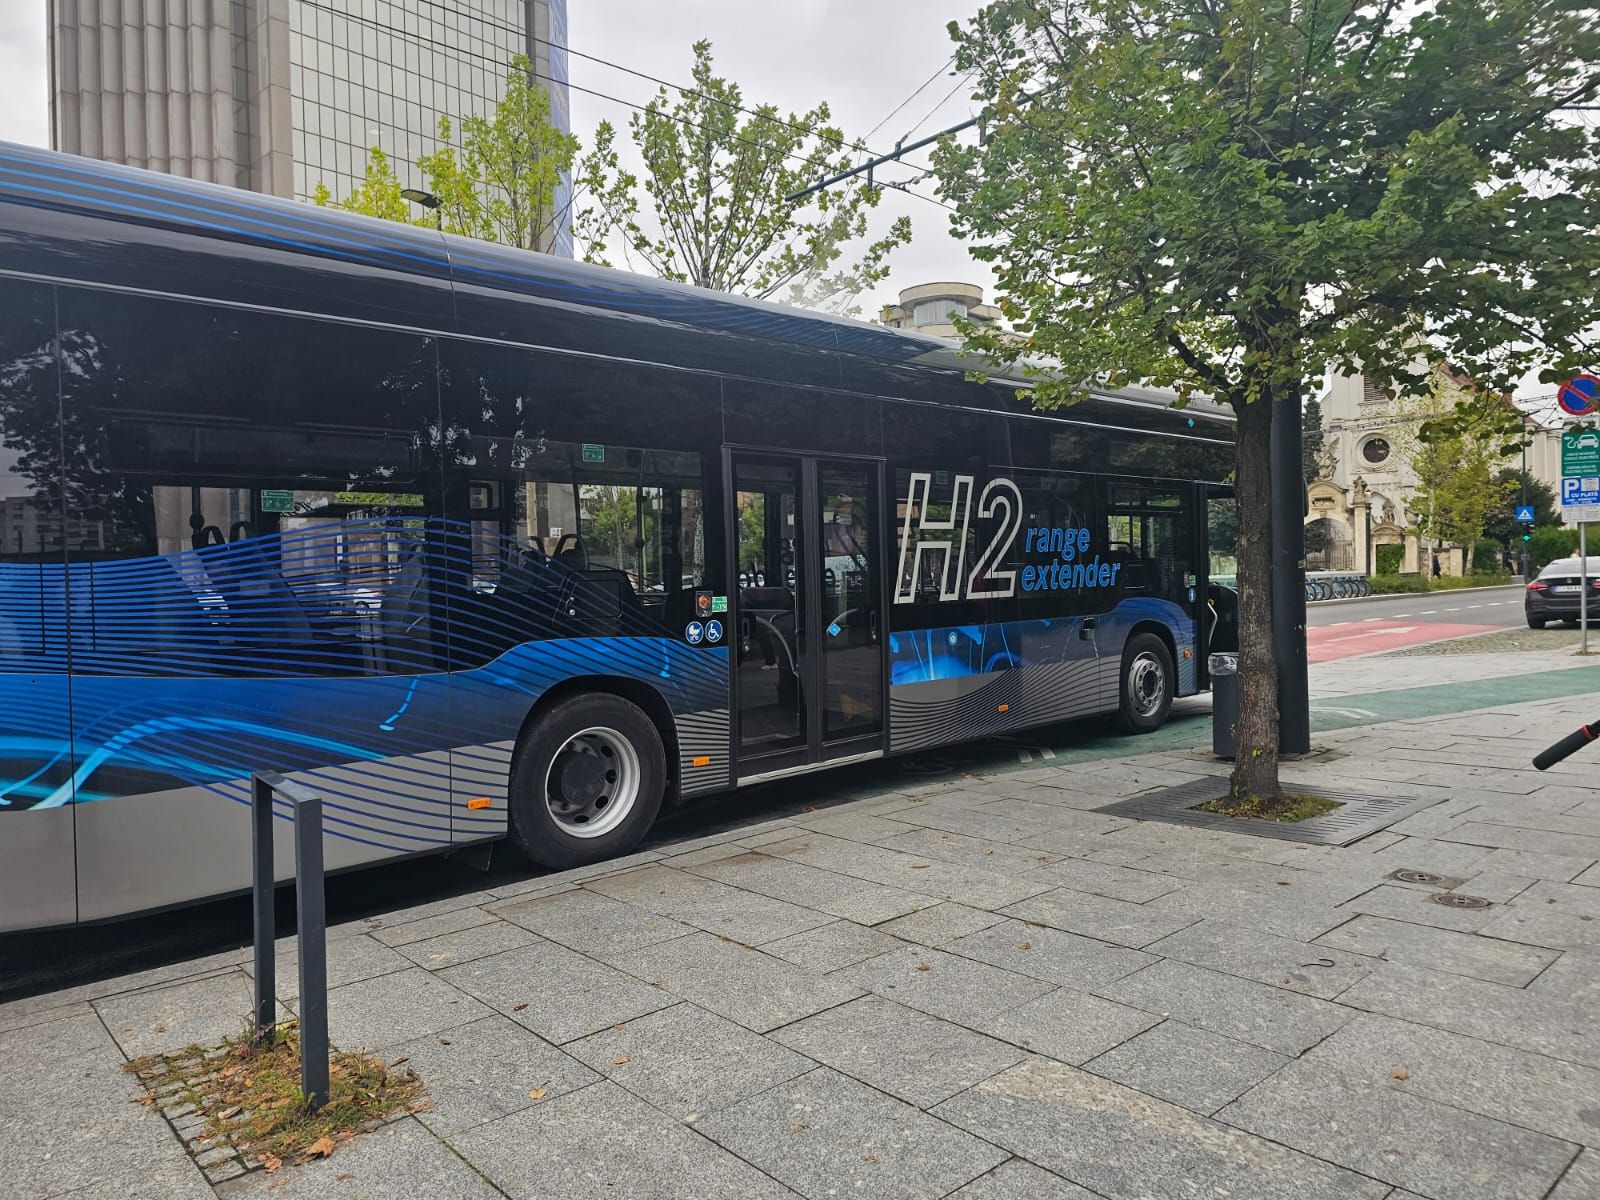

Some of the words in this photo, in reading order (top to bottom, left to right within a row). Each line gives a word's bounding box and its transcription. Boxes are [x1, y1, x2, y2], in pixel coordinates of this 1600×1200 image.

[1564, 479, 1579, 498] P
[893, 472, 1023, 604] H2
[1025, 527, 1091, 562] range
[1021, 555, 1121, 592] extender
